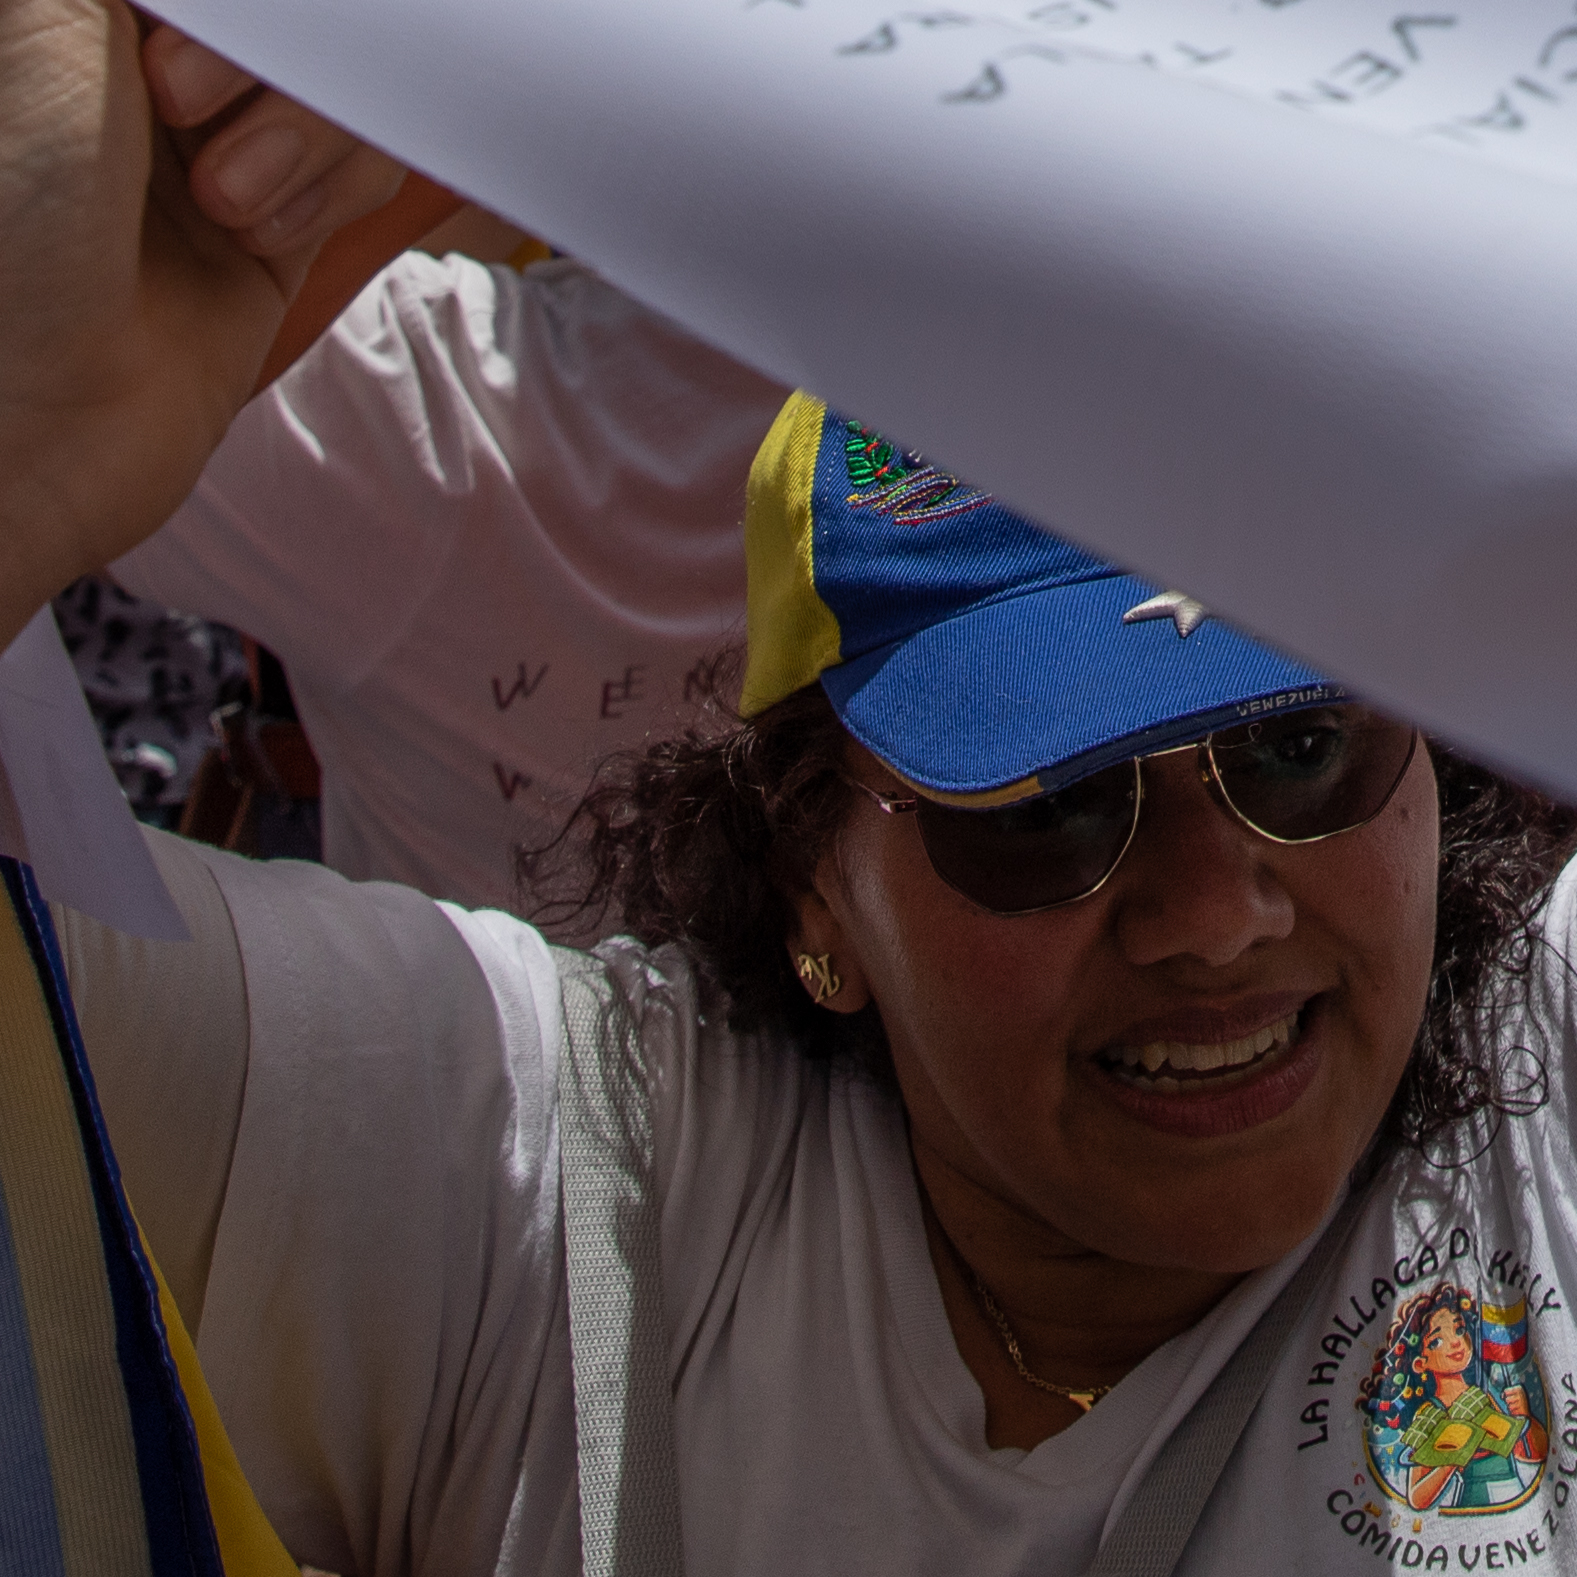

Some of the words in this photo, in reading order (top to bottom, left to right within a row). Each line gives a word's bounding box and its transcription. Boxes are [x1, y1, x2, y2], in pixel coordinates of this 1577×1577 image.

[1308, 1243, 1440, 1388] HALLACA
[1297, 1398, 1330, 1452] LA
[1326, 1488, 1450, 1572] COMIDA
